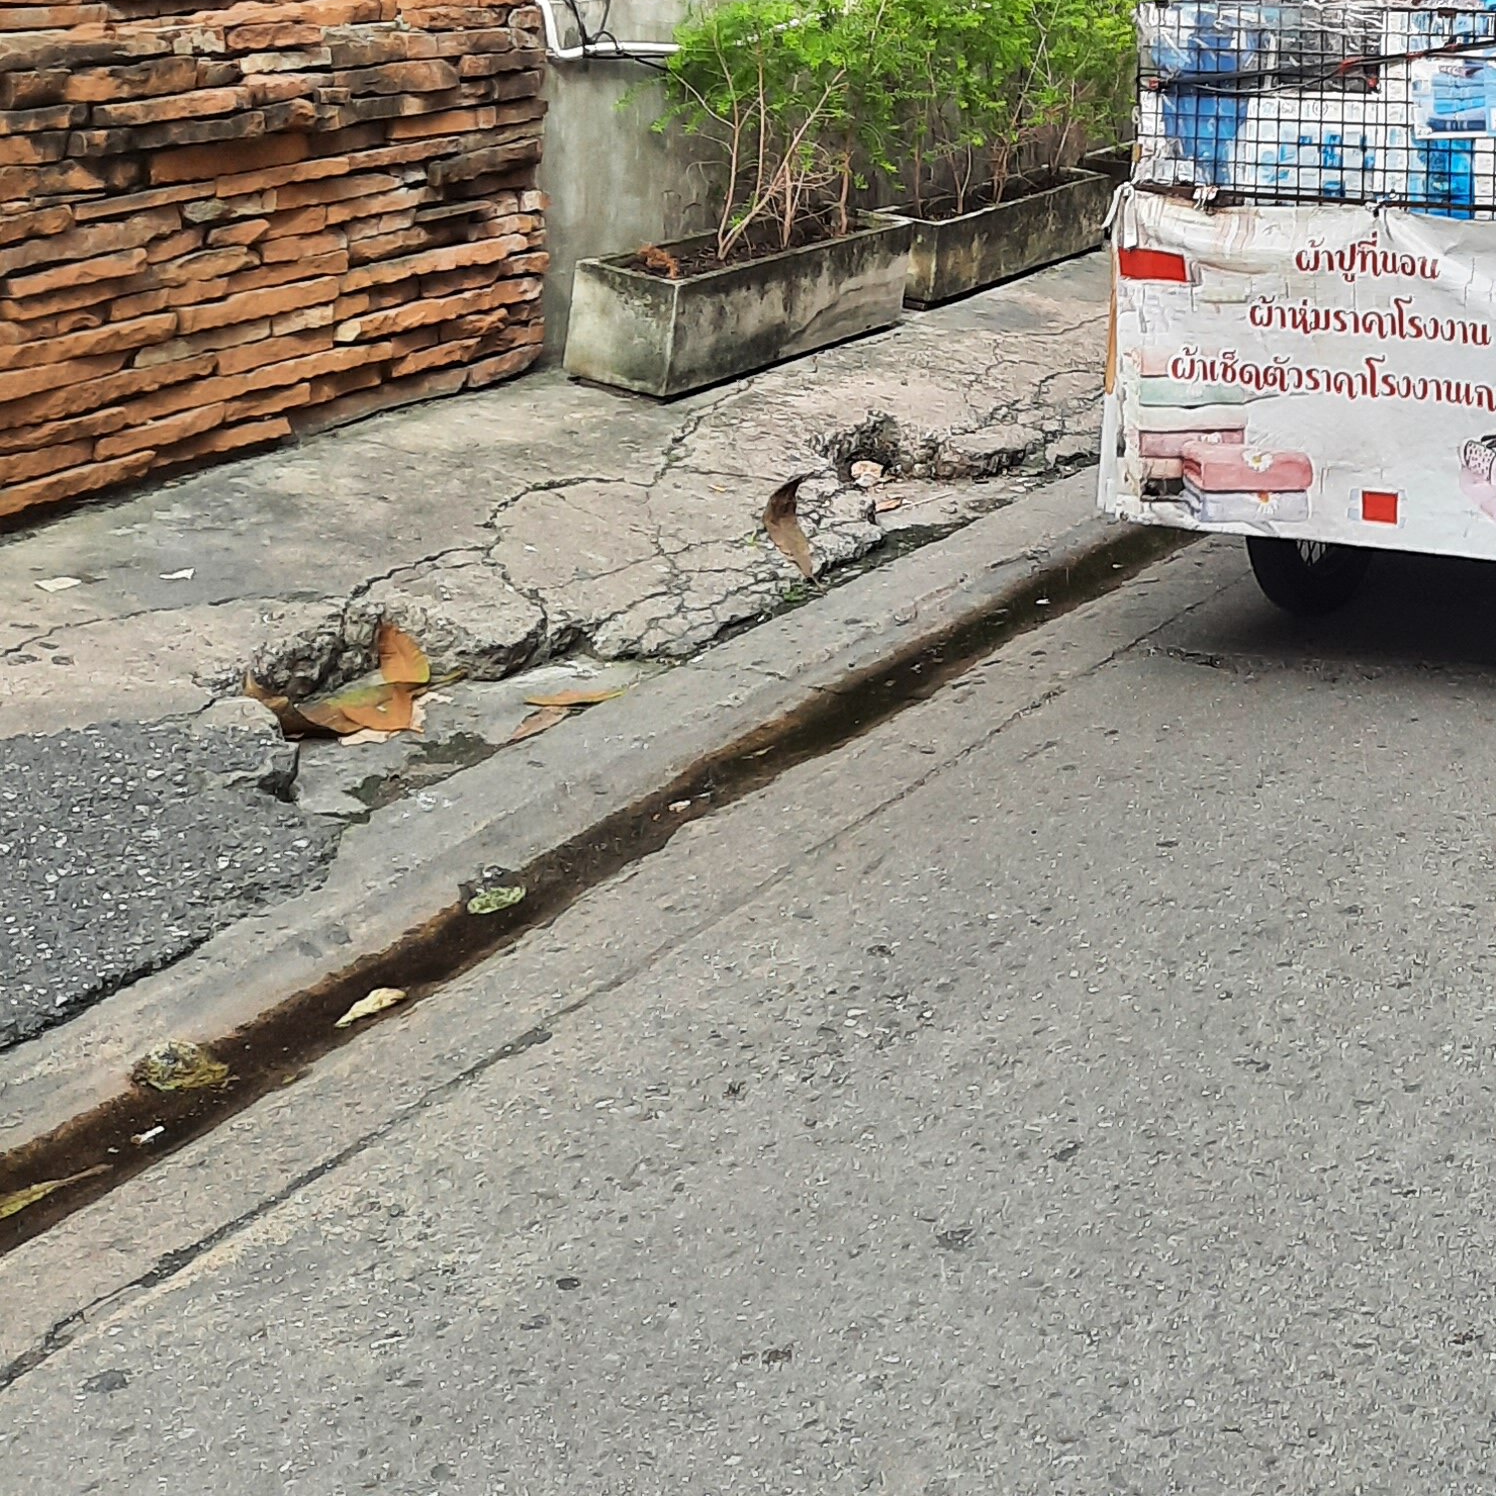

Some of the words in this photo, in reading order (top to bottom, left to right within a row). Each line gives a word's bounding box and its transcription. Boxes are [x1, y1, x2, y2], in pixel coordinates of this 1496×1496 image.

[1295, 230, 1441, 283] ผ้าปูที่นอน
[1249, 295, 1492, 346] ผ้าห่มราคาโรงงาน
